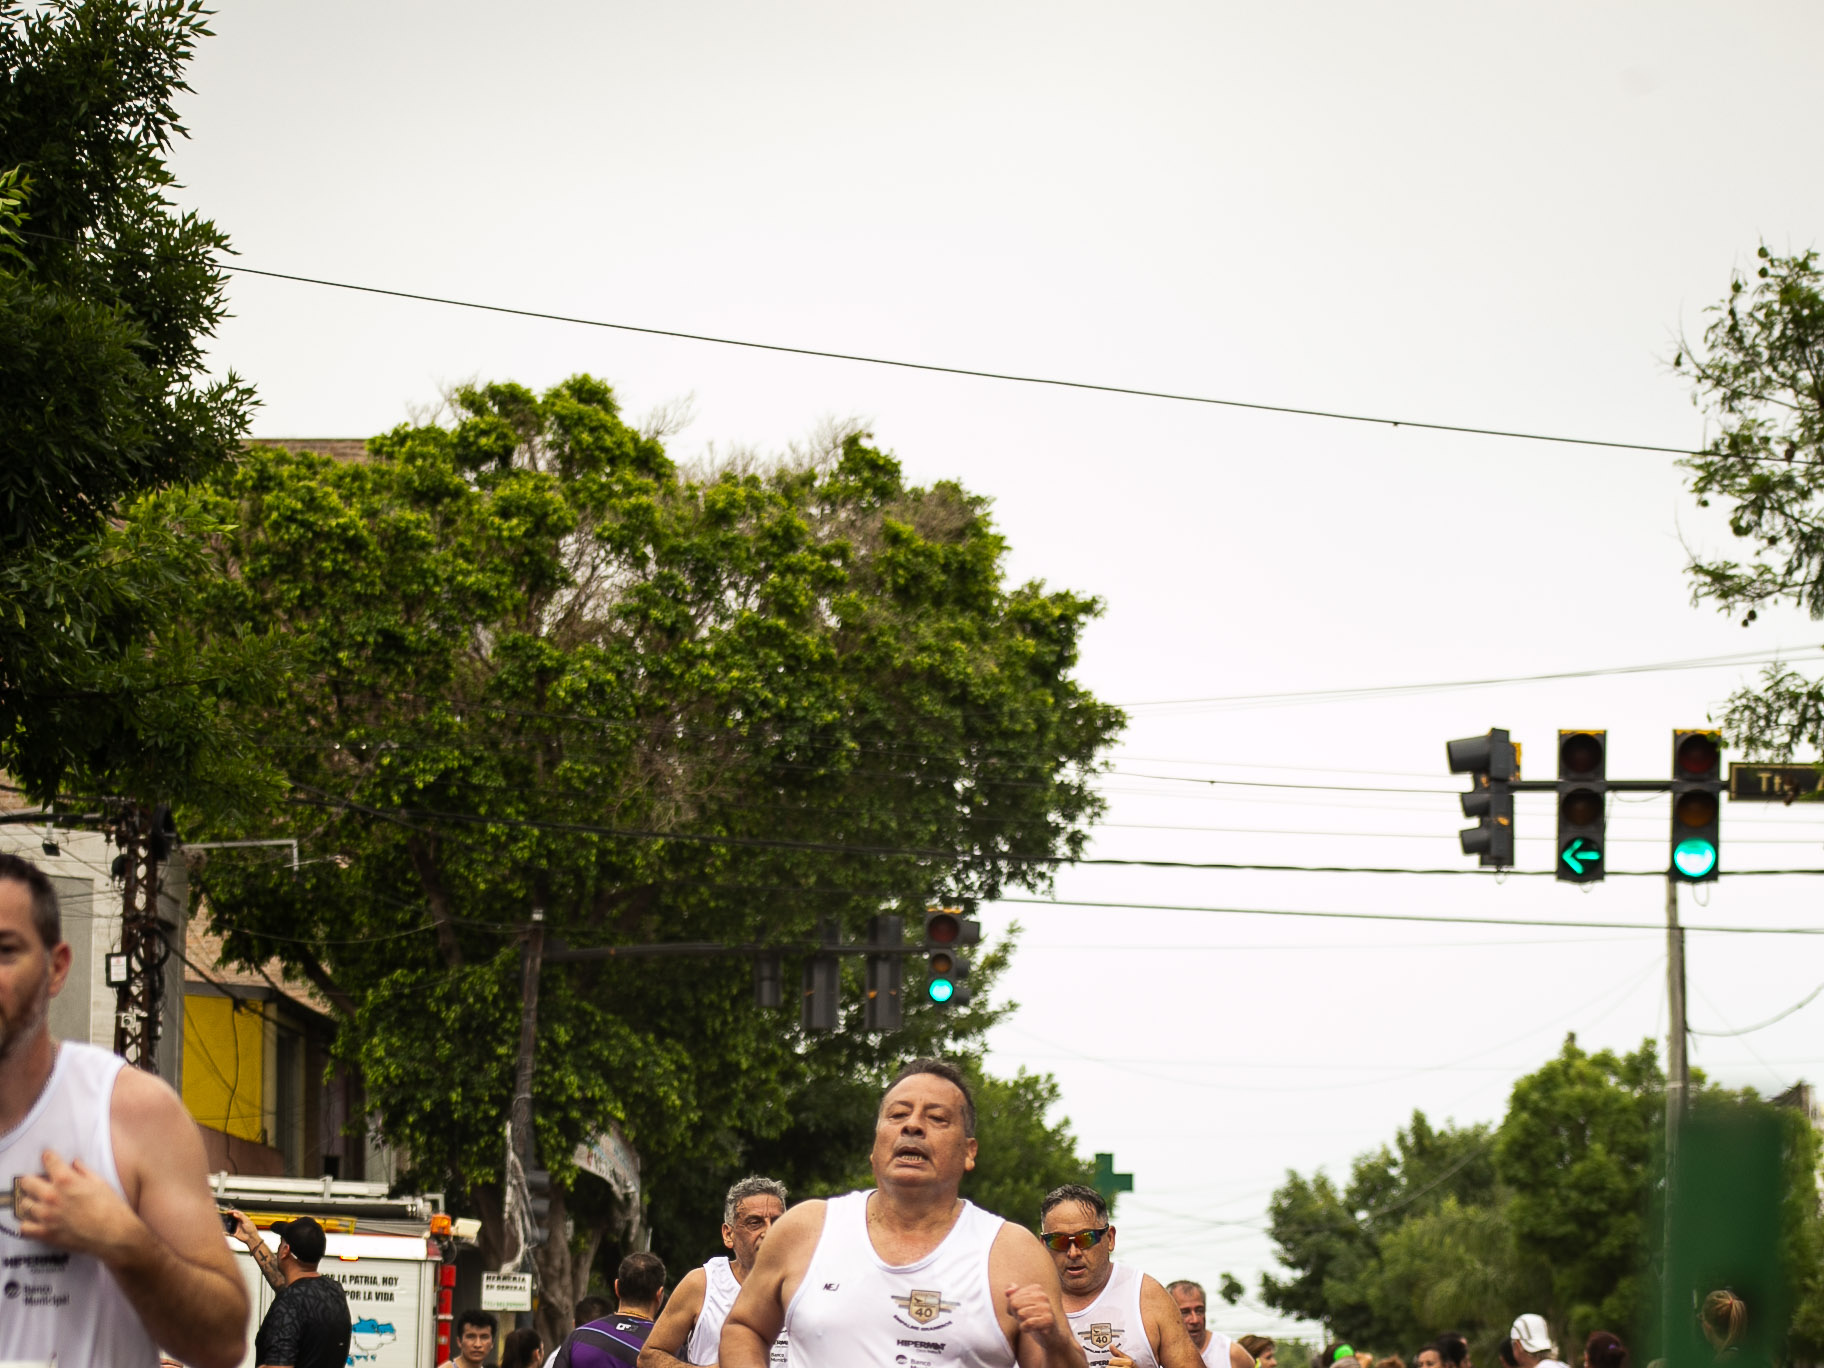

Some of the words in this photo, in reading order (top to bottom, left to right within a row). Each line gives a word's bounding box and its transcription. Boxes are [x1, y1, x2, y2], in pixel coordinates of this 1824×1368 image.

[382, 1277, 398, 1286] HOY
[363, 1291, 372, 1301] LA
[375, 1291, 395, 1302] VIDA
[915, 1308, 933, 1318] 40
[1096, 1336, 1108, 1344] 40
[910, 1358, 931, 1367] Banco
